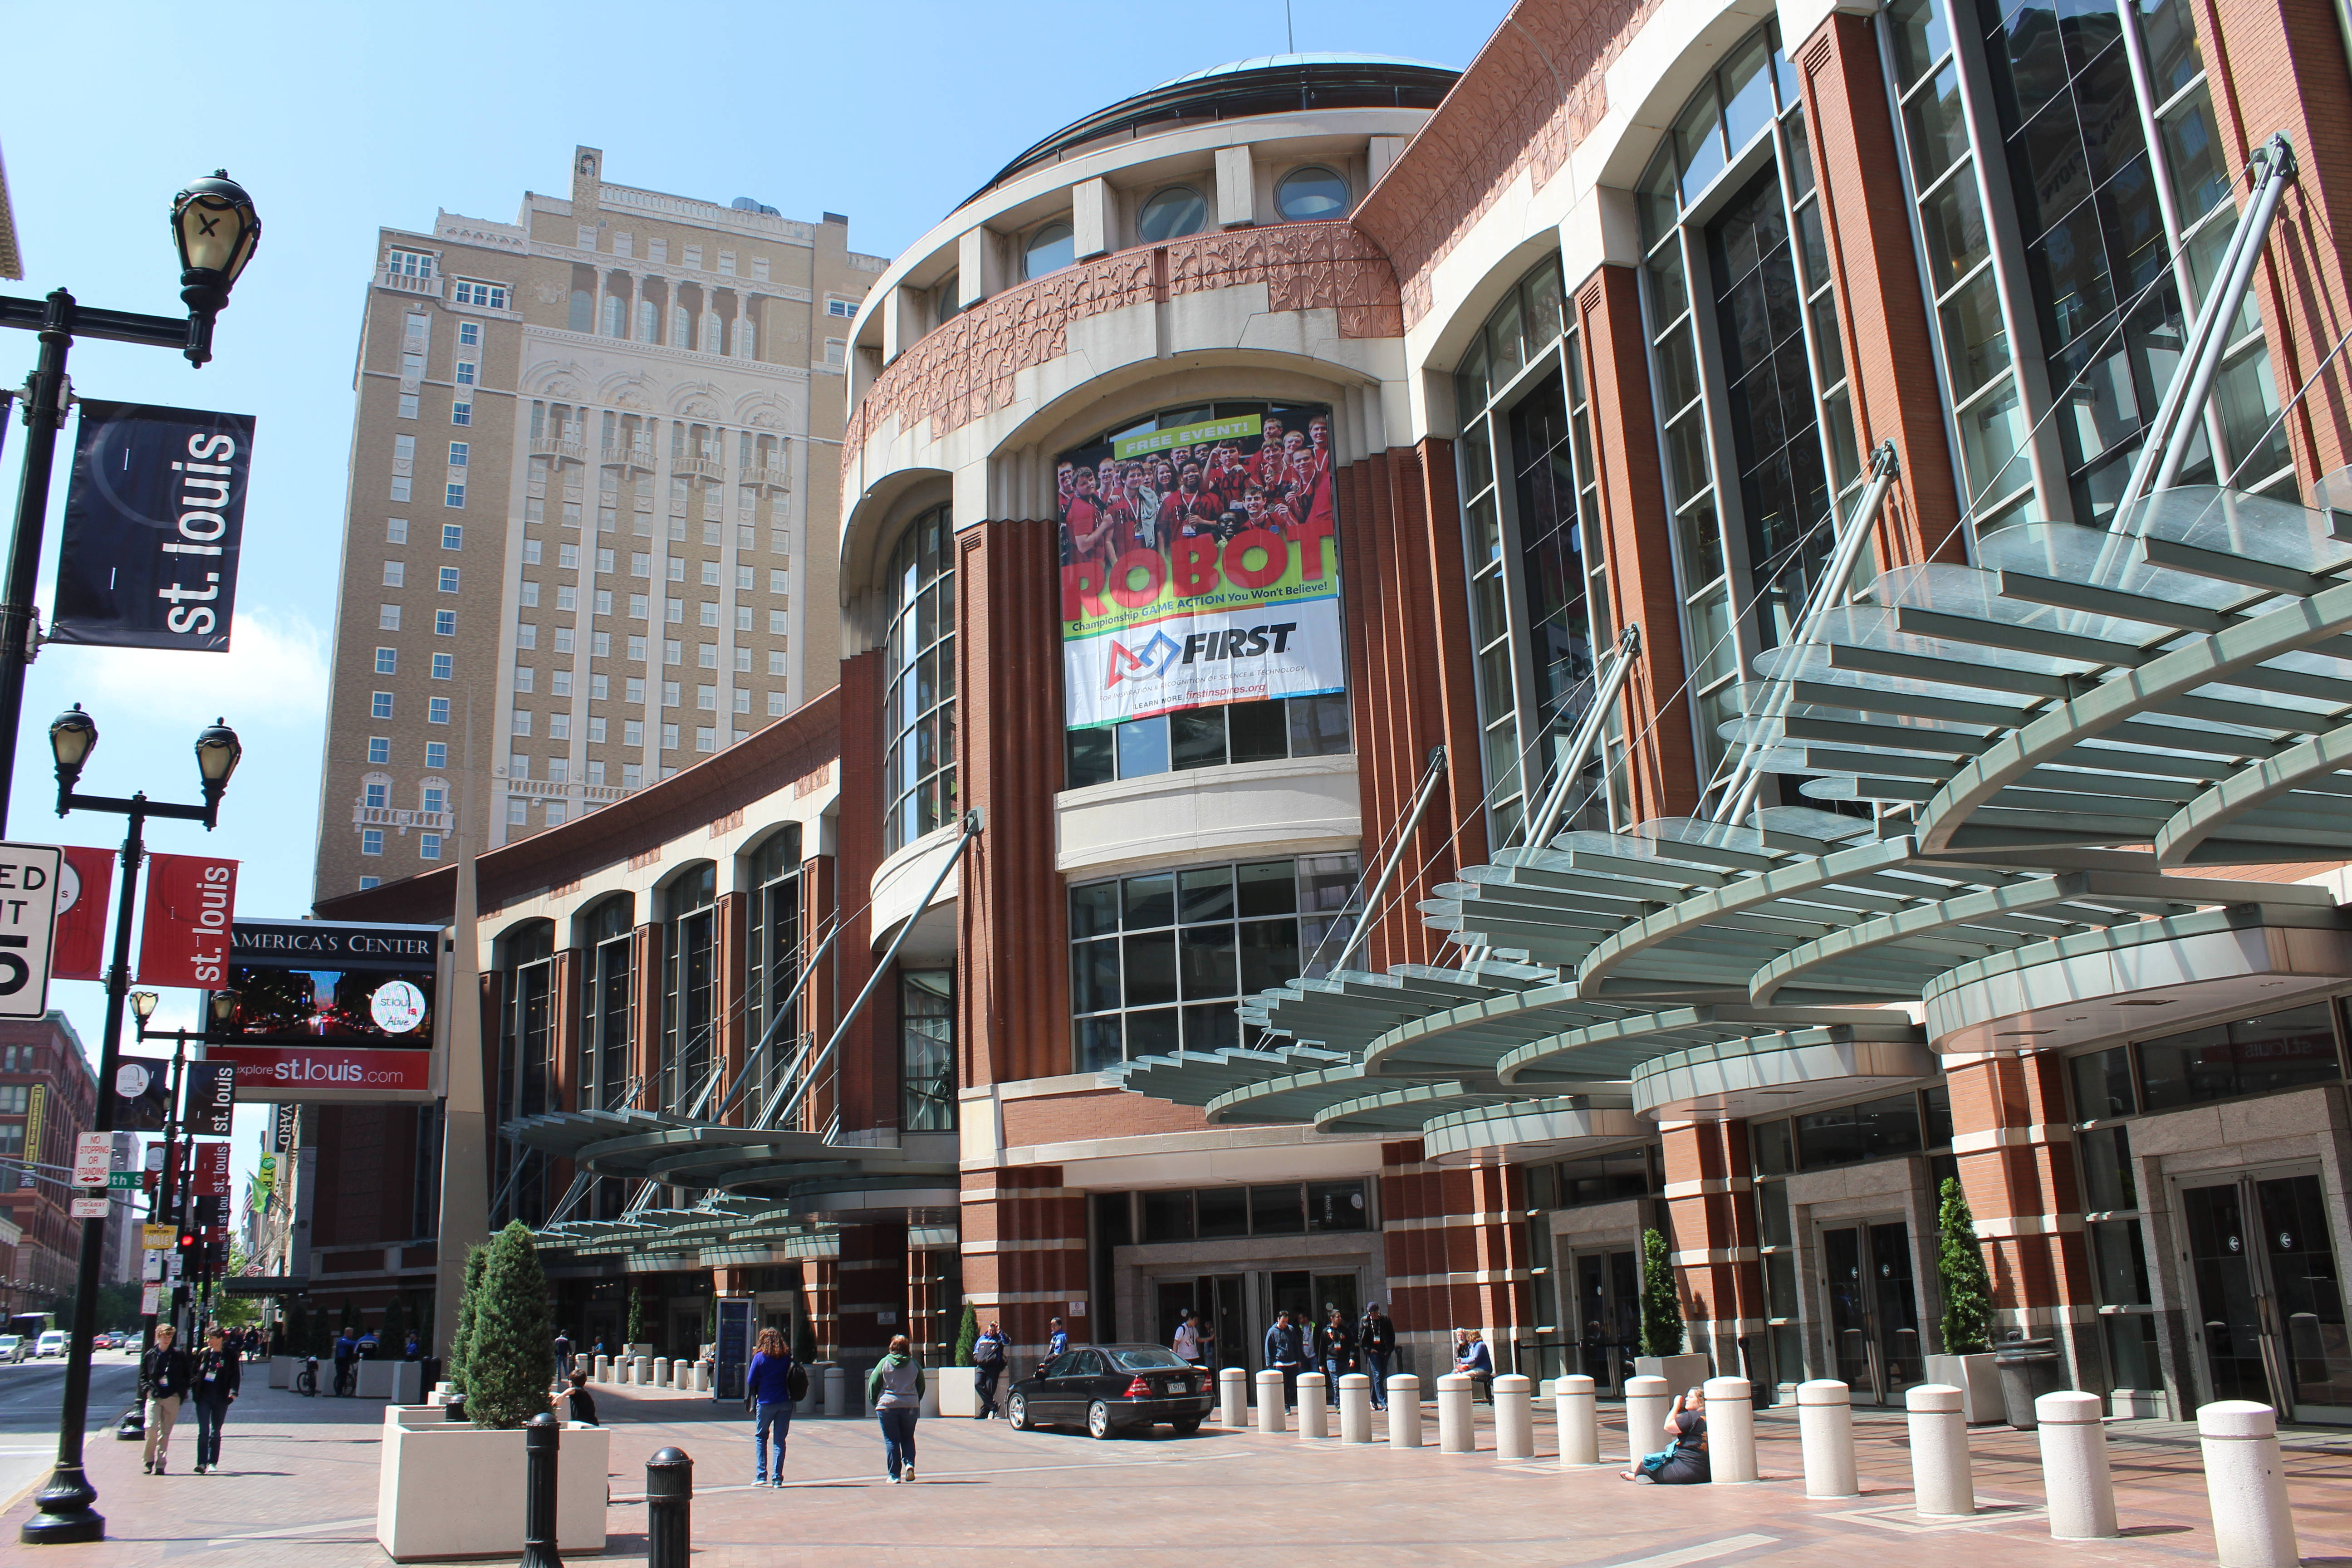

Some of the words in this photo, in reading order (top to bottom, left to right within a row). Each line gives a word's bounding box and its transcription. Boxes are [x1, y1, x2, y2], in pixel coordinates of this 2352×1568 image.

[1126, 434, 1172, 454] FREE
[1180, 422, 1248, 442] EVENT!
[162, 433, 235, 556] louis
[1062, 519, 1334, 621] ROBOT
[158, 572, 220, 635] st.
[1072, 611, 1138, 631] Championship
[1142, 601, 1173, 617] GAME
[1177, 594, 1224, 608] ACTION
[1228, 593, 1248, 602] You
[1251, 587, 1283, 599] Won't
[1286, 581, 1328, 595] Believe!
[1182, 622, 1297, 664] FIRST
[1113, 687, 1152, 699] INSPIRATION
[1161, 677, 1206, 689] RECOGNITION
[1219, 671, 1247, 680] SCIENCE
[1257, 666, 1305, 676] TECHNOLOGY
[1134, 700, 1158, 709] LEARN
[1161, 694, 1182, 704] MORE
[1186, 684, 1266, 700] firstinspires.org
[192, 866, 229, 935] louis
[230, 931, 338, 951] AMERICA'S
[348, 935, 430, 954] CENTER
[191, 947, 221, 982] st.
[384, 1015, 411, 1026] Alive
[212, 1068, 233, 1107] louis
[211, 1112, 229, 1132] st.
[77, 1167, 107, 1176] STANDING
[88, 1156, 98, 1164] OR
[213, 1146, 227, 1174] louis
[212, 1176, 225, 1193] st.
[144, 1234, 175, 1246] TROLLEY
